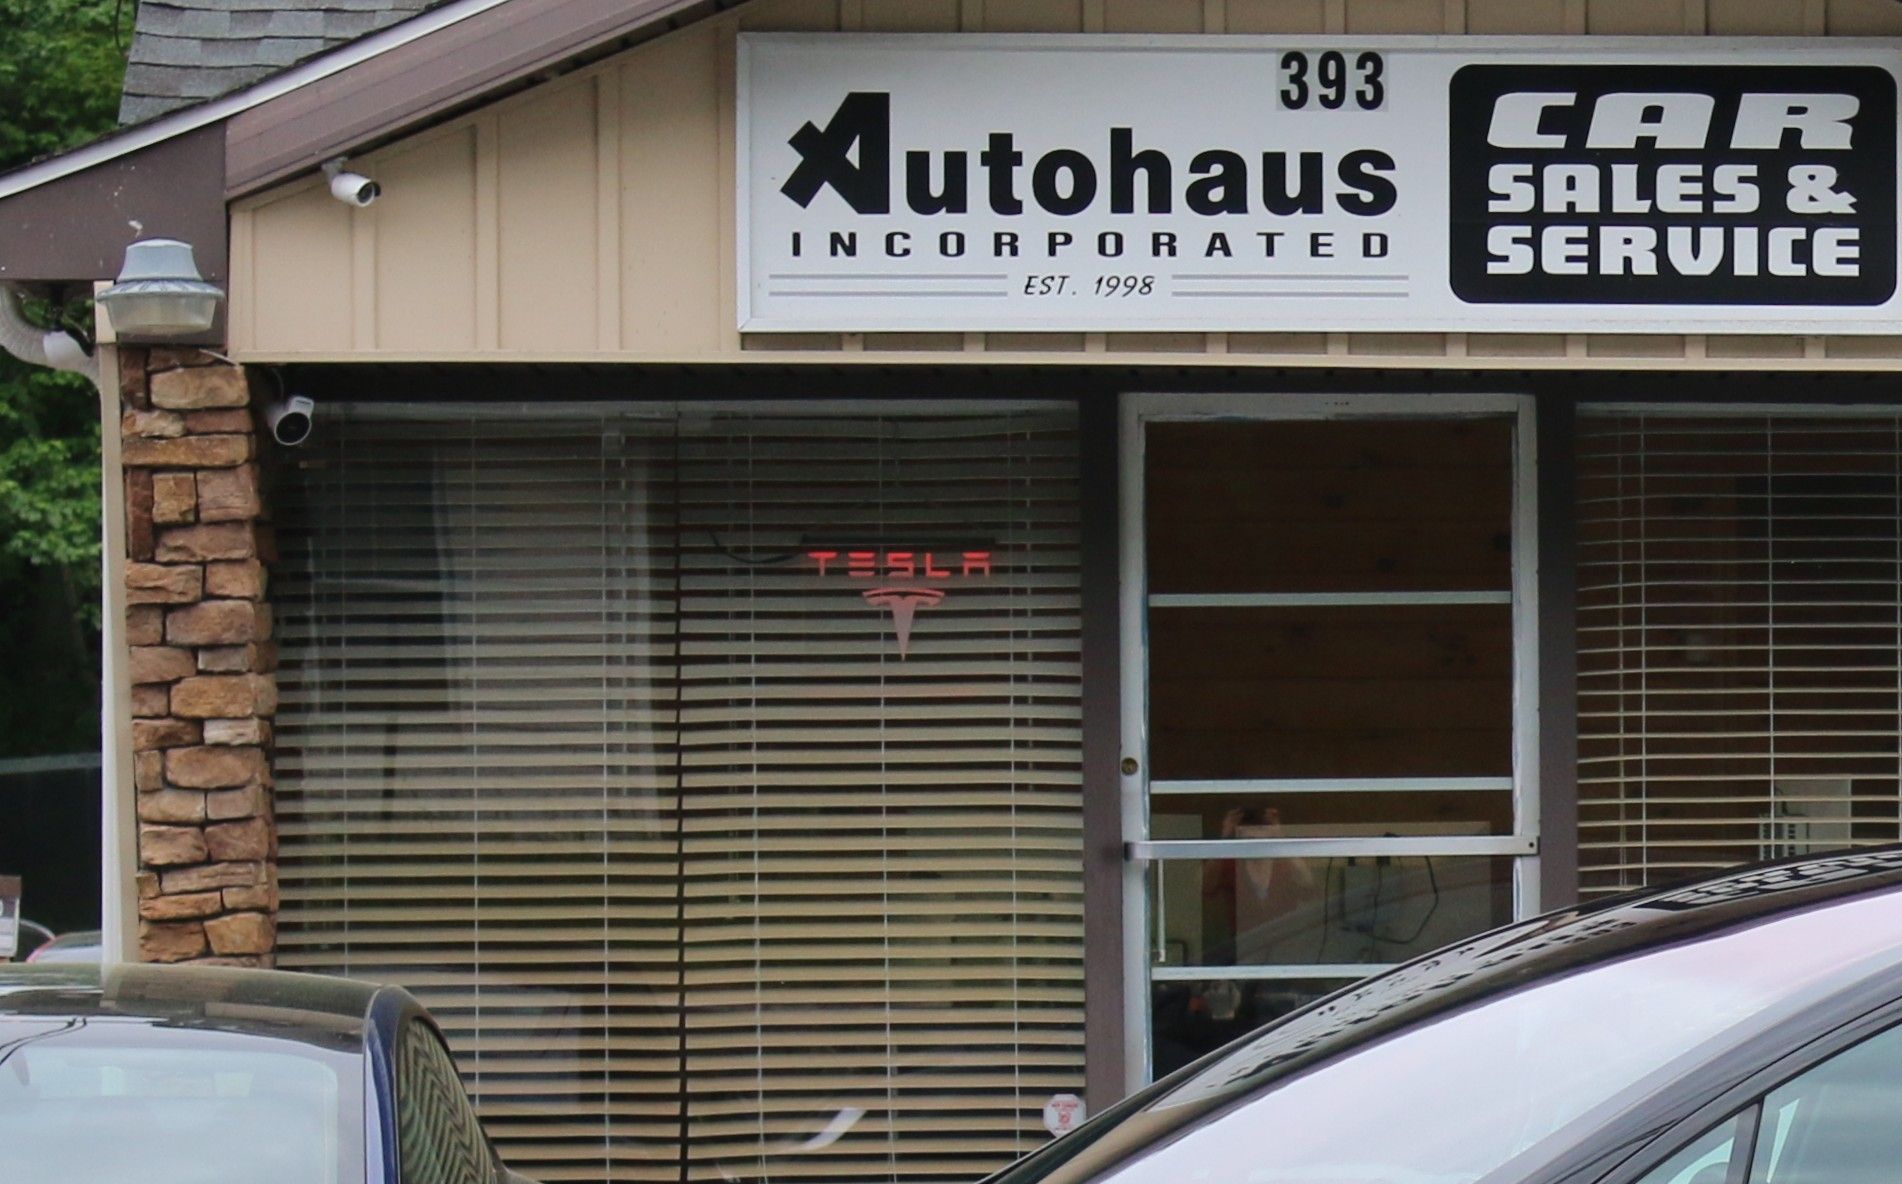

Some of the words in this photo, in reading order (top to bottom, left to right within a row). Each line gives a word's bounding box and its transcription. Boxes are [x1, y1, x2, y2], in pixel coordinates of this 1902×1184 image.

[1279, 51, 1384, 110] 393
[1487, 91, 1860, 150] CAR
[780, 91, 1398, 215] Autohaus
[1488, 163, 1760, 213] SALES
[1786, 164, 1857, 214] &
[791, 230, 1389, 258] INCORPORATED
[1487, 225, 1860, 277] SERVICE
[1023, 274, 1077, 296] EST.
[1093, 274, 1156, 297] 1998
[808, 552, 991, 577] TESLA
